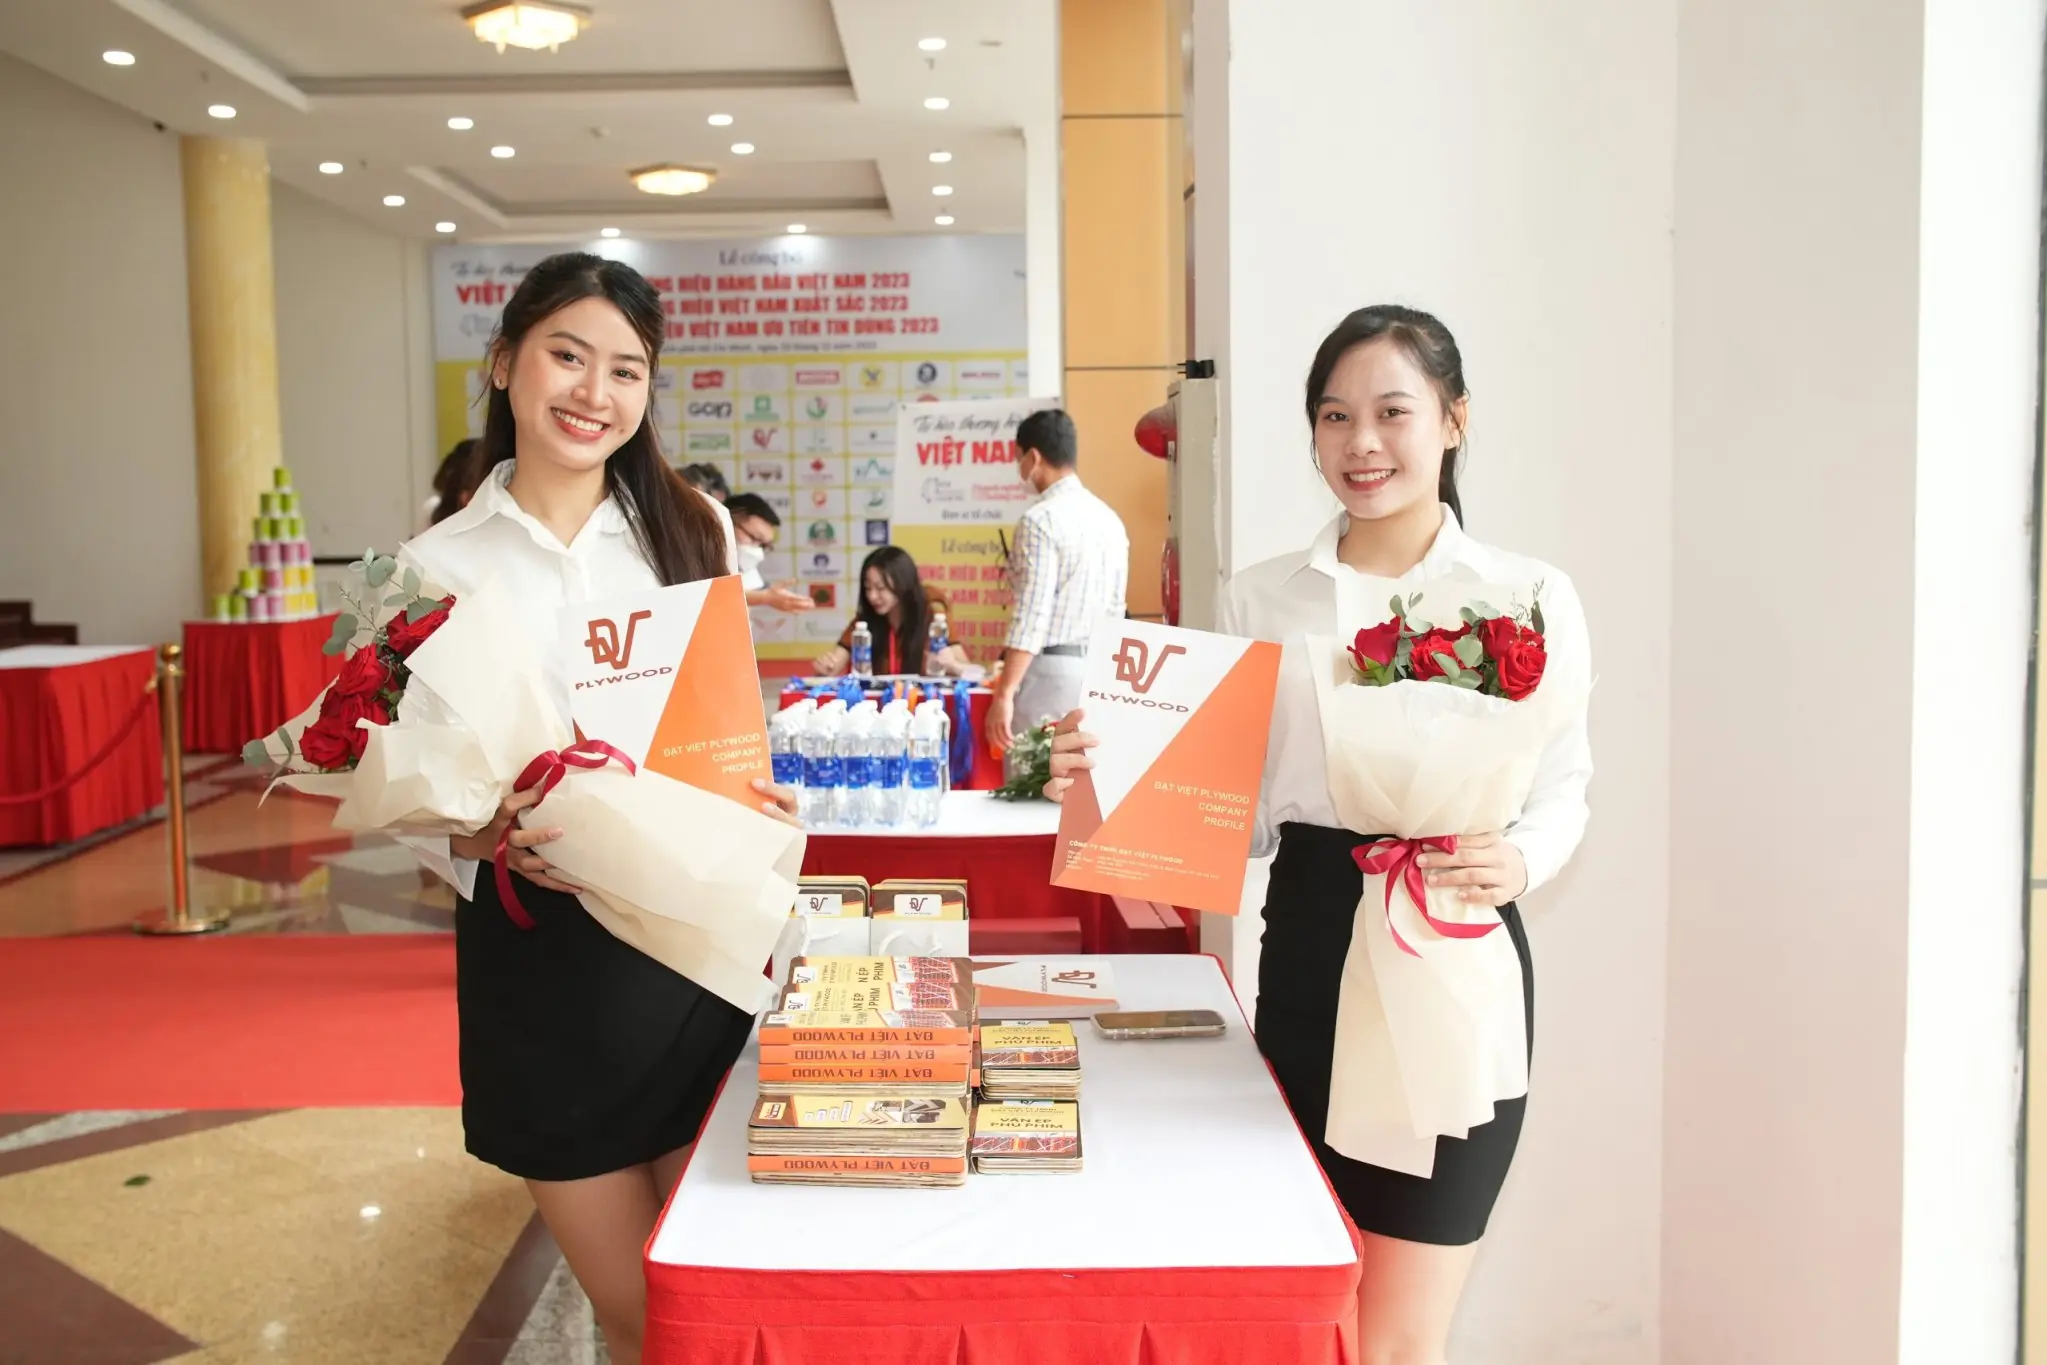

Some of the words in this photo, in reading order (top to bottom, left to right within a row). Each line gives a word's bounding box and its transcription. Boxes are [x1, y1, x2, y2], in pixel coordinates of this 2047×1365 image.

[796, 272, 827, 291] VIỆT
[833, 273, 866, 289] NAM
[871, 272, 910, 289] 2023
[455, 279, 507, 309] VIỆT
[755, 297, 788, 313] NAM
[870, 295, 909, 312] 2023
[726, 320, 758, 336] NAM
[900, 316, 939, 334] 2023
[916, 434, 966, 471] VIỆT
[575, 666, 673, 690] PLYWOOD
[1088, 690, 1190, 713] PLYWOOD
[709, 732, 761, 749] PLYWOOD
[712, 746, 762, 762] COMPANY
[722, 760, 764, 774] PROFILE
[1199, 788, 1250, 805] PLYWOOD
[1199, 802, 1248, 817] COMPANY
[1203, 815, 1245, 831] PROFILE
[873, 962, 884, 980] PHIM
[868, 987, 881, 1006] PHIM
[793, 1031, 864, 1041] PLYWOOD
[794, 1049, 866, 1060] PLYWOOD
[792, 1068, 863, 1078] PLYWOOD
[784, 1160, 858, 1169] PLYWOOD
